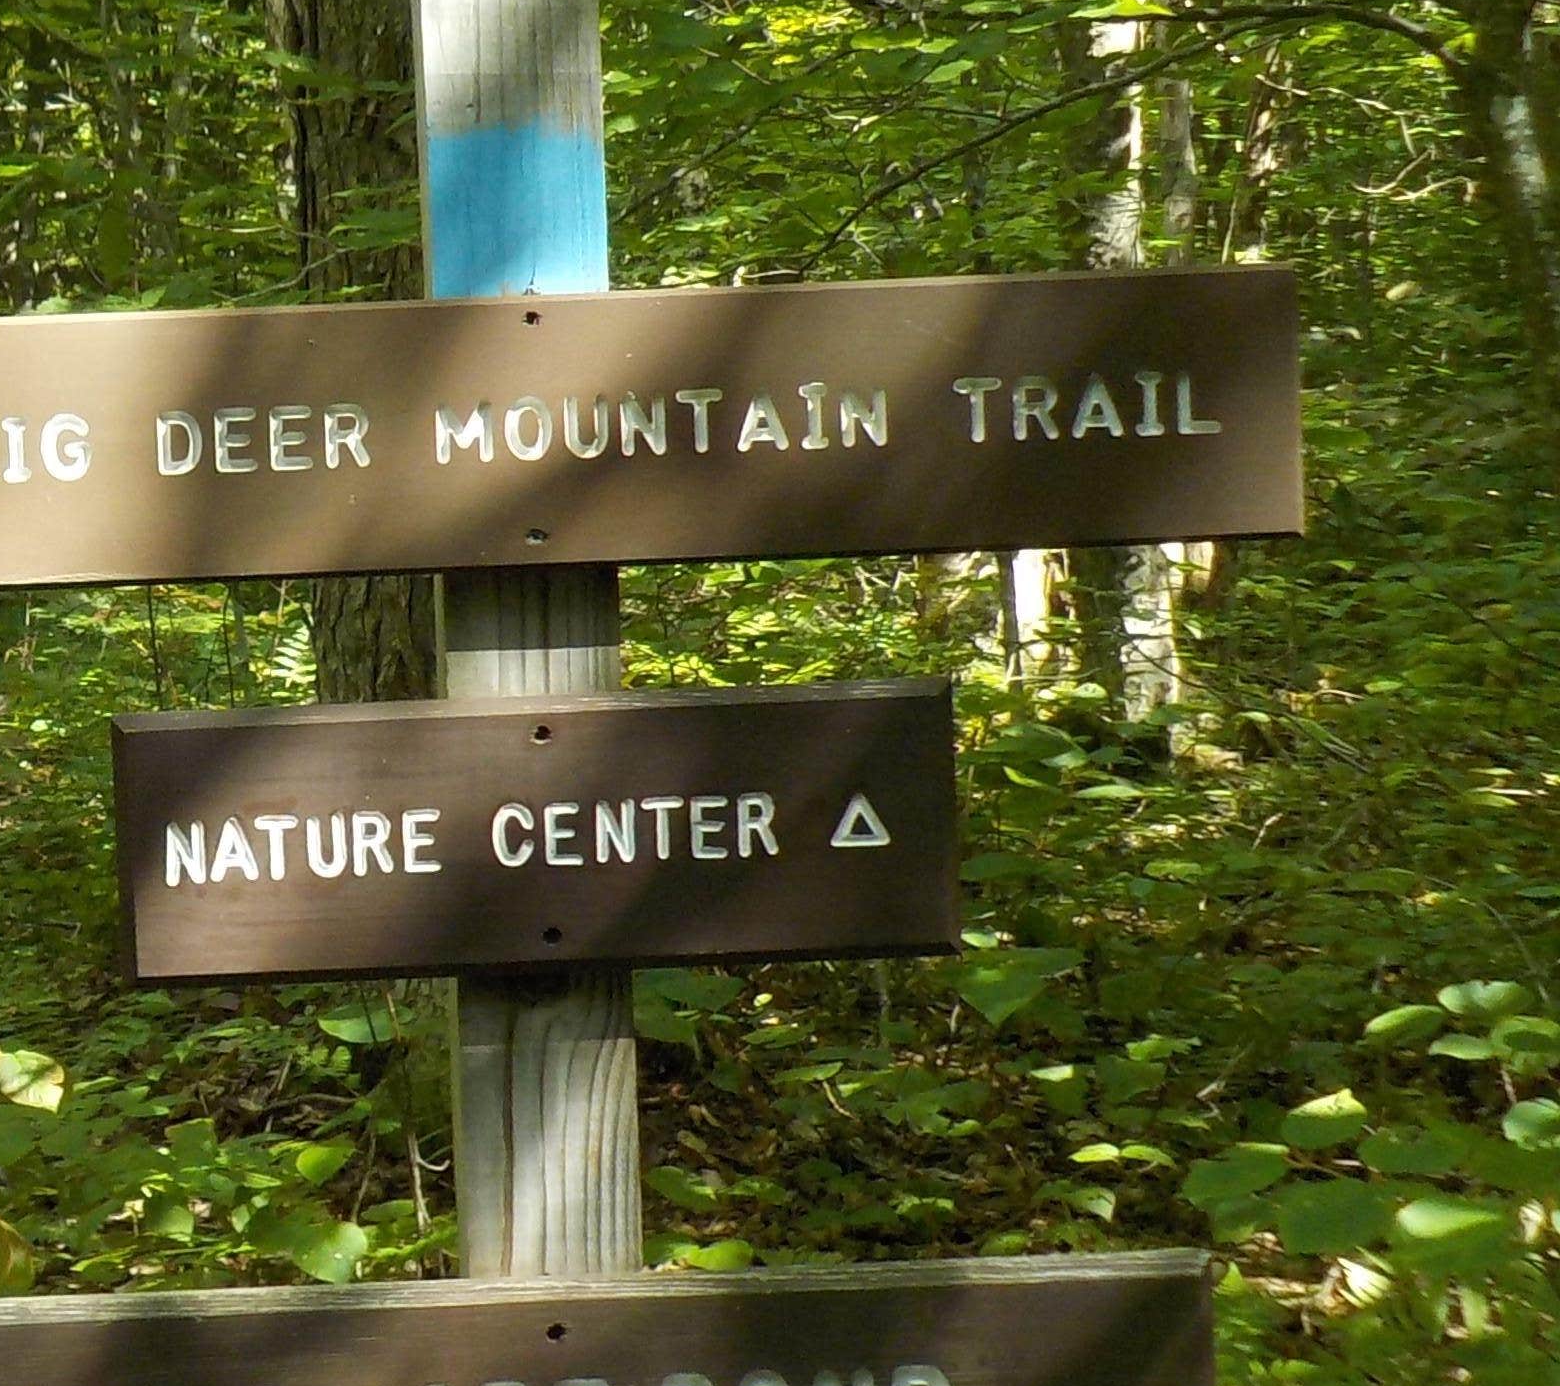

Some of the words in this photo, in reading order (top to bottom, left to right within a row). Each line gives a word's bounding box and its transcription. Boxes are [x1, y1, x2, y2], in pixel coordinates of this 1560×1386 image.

[156, 403, 370, 477] DEER
[435, 381, 888, 464] MOUNTAIN
[952, 371, 1222, 443] TRAIL
[164, 808, 441, 886] NATURE
[492, 792, 779, 867] CENTER
